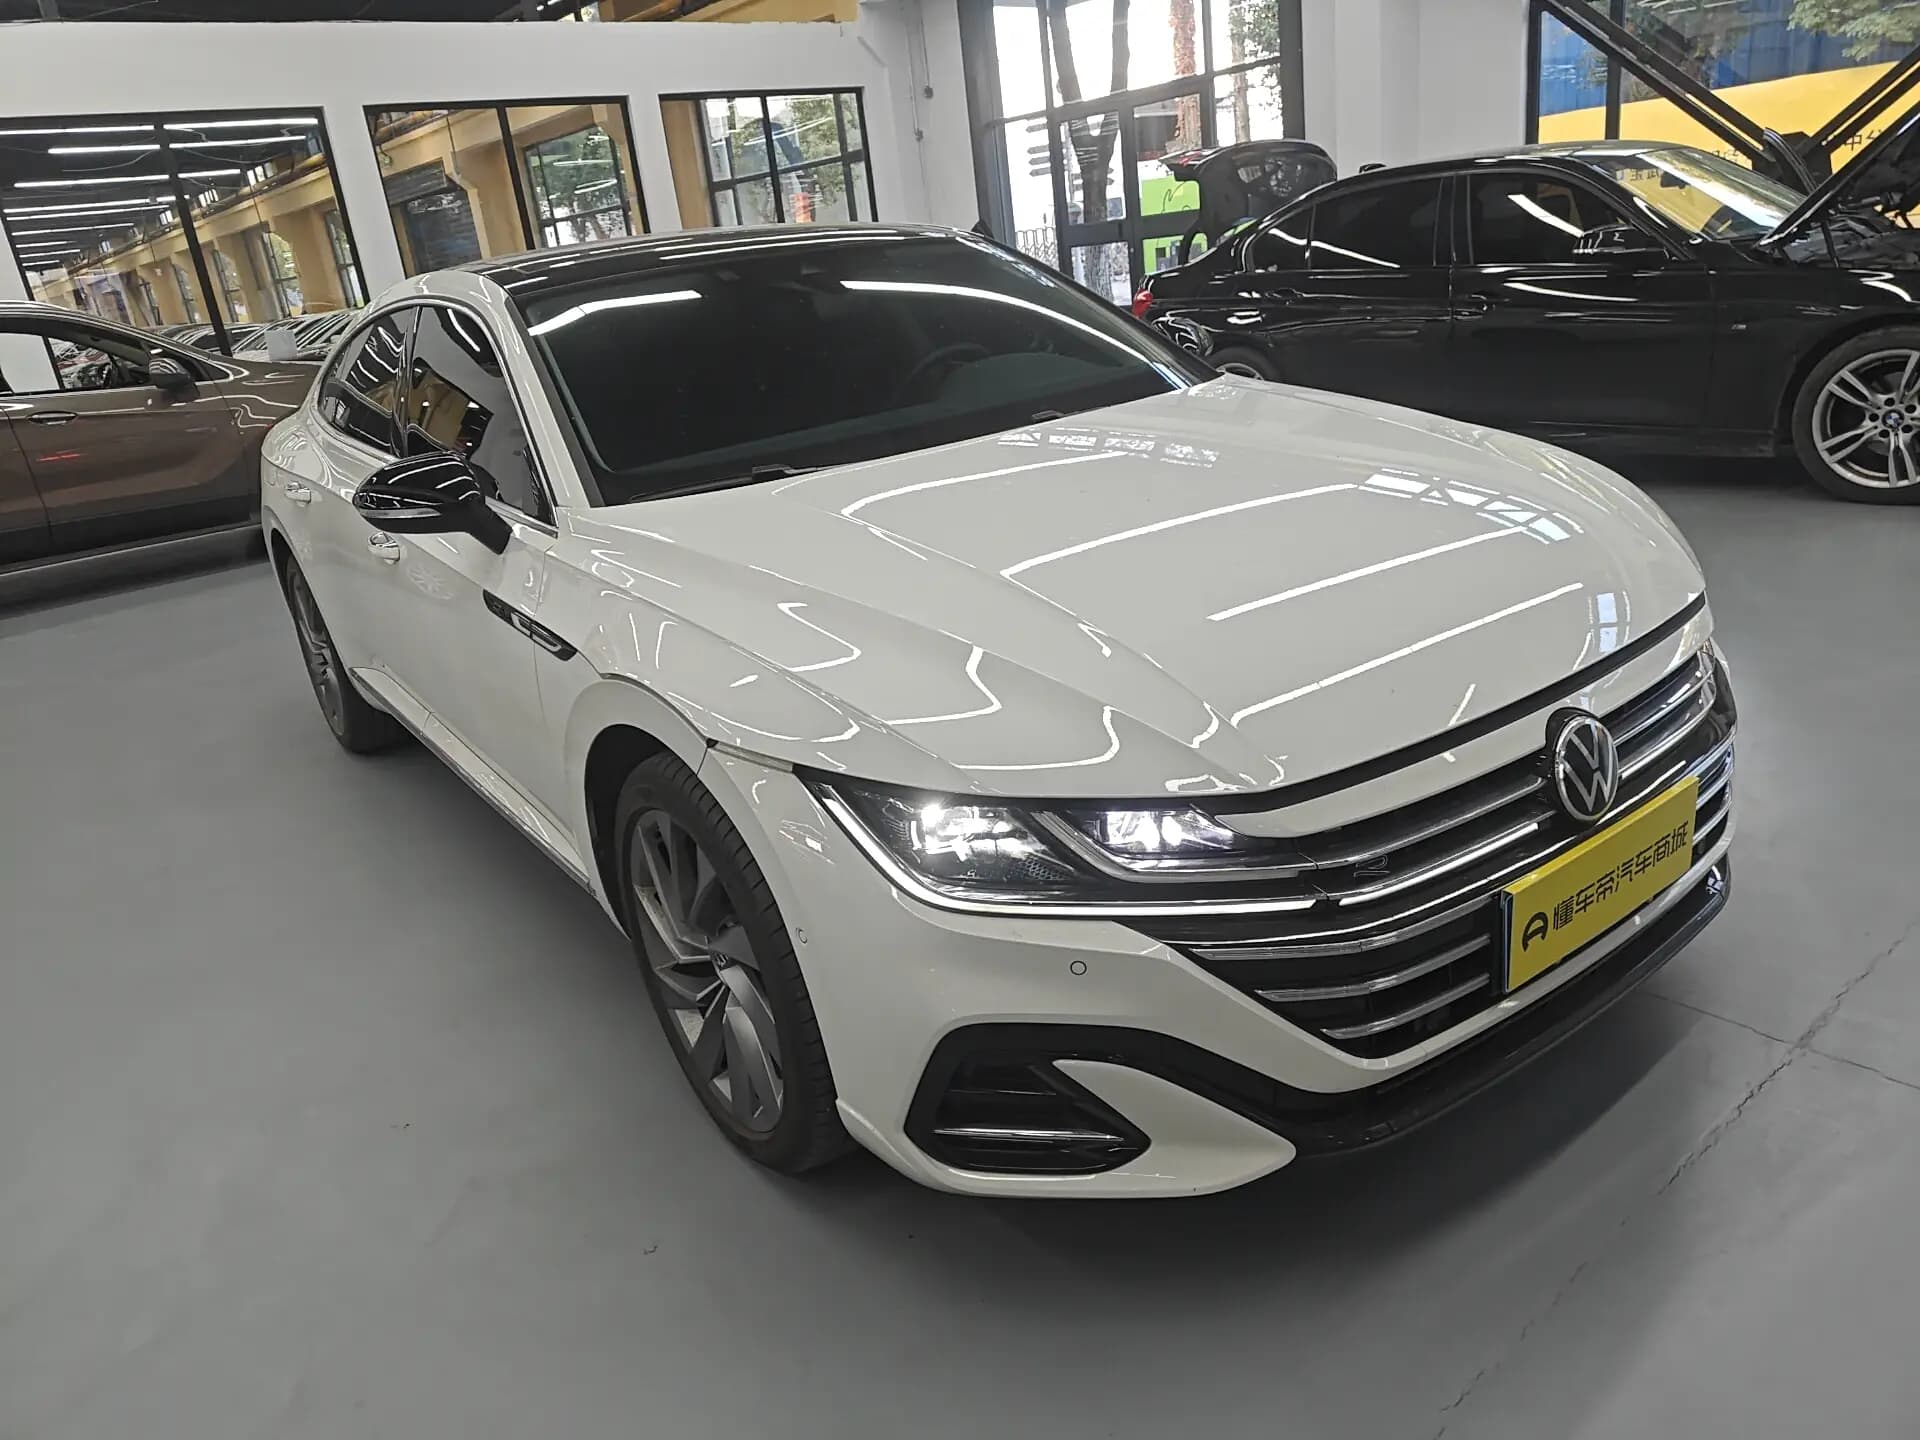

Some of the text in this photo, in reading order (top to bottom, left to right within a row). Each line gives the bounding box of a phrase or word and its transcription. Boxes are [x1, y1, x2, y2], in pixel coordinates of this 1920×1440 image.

[1553, 820, 1689, 931] 懂车帝汽车商城
